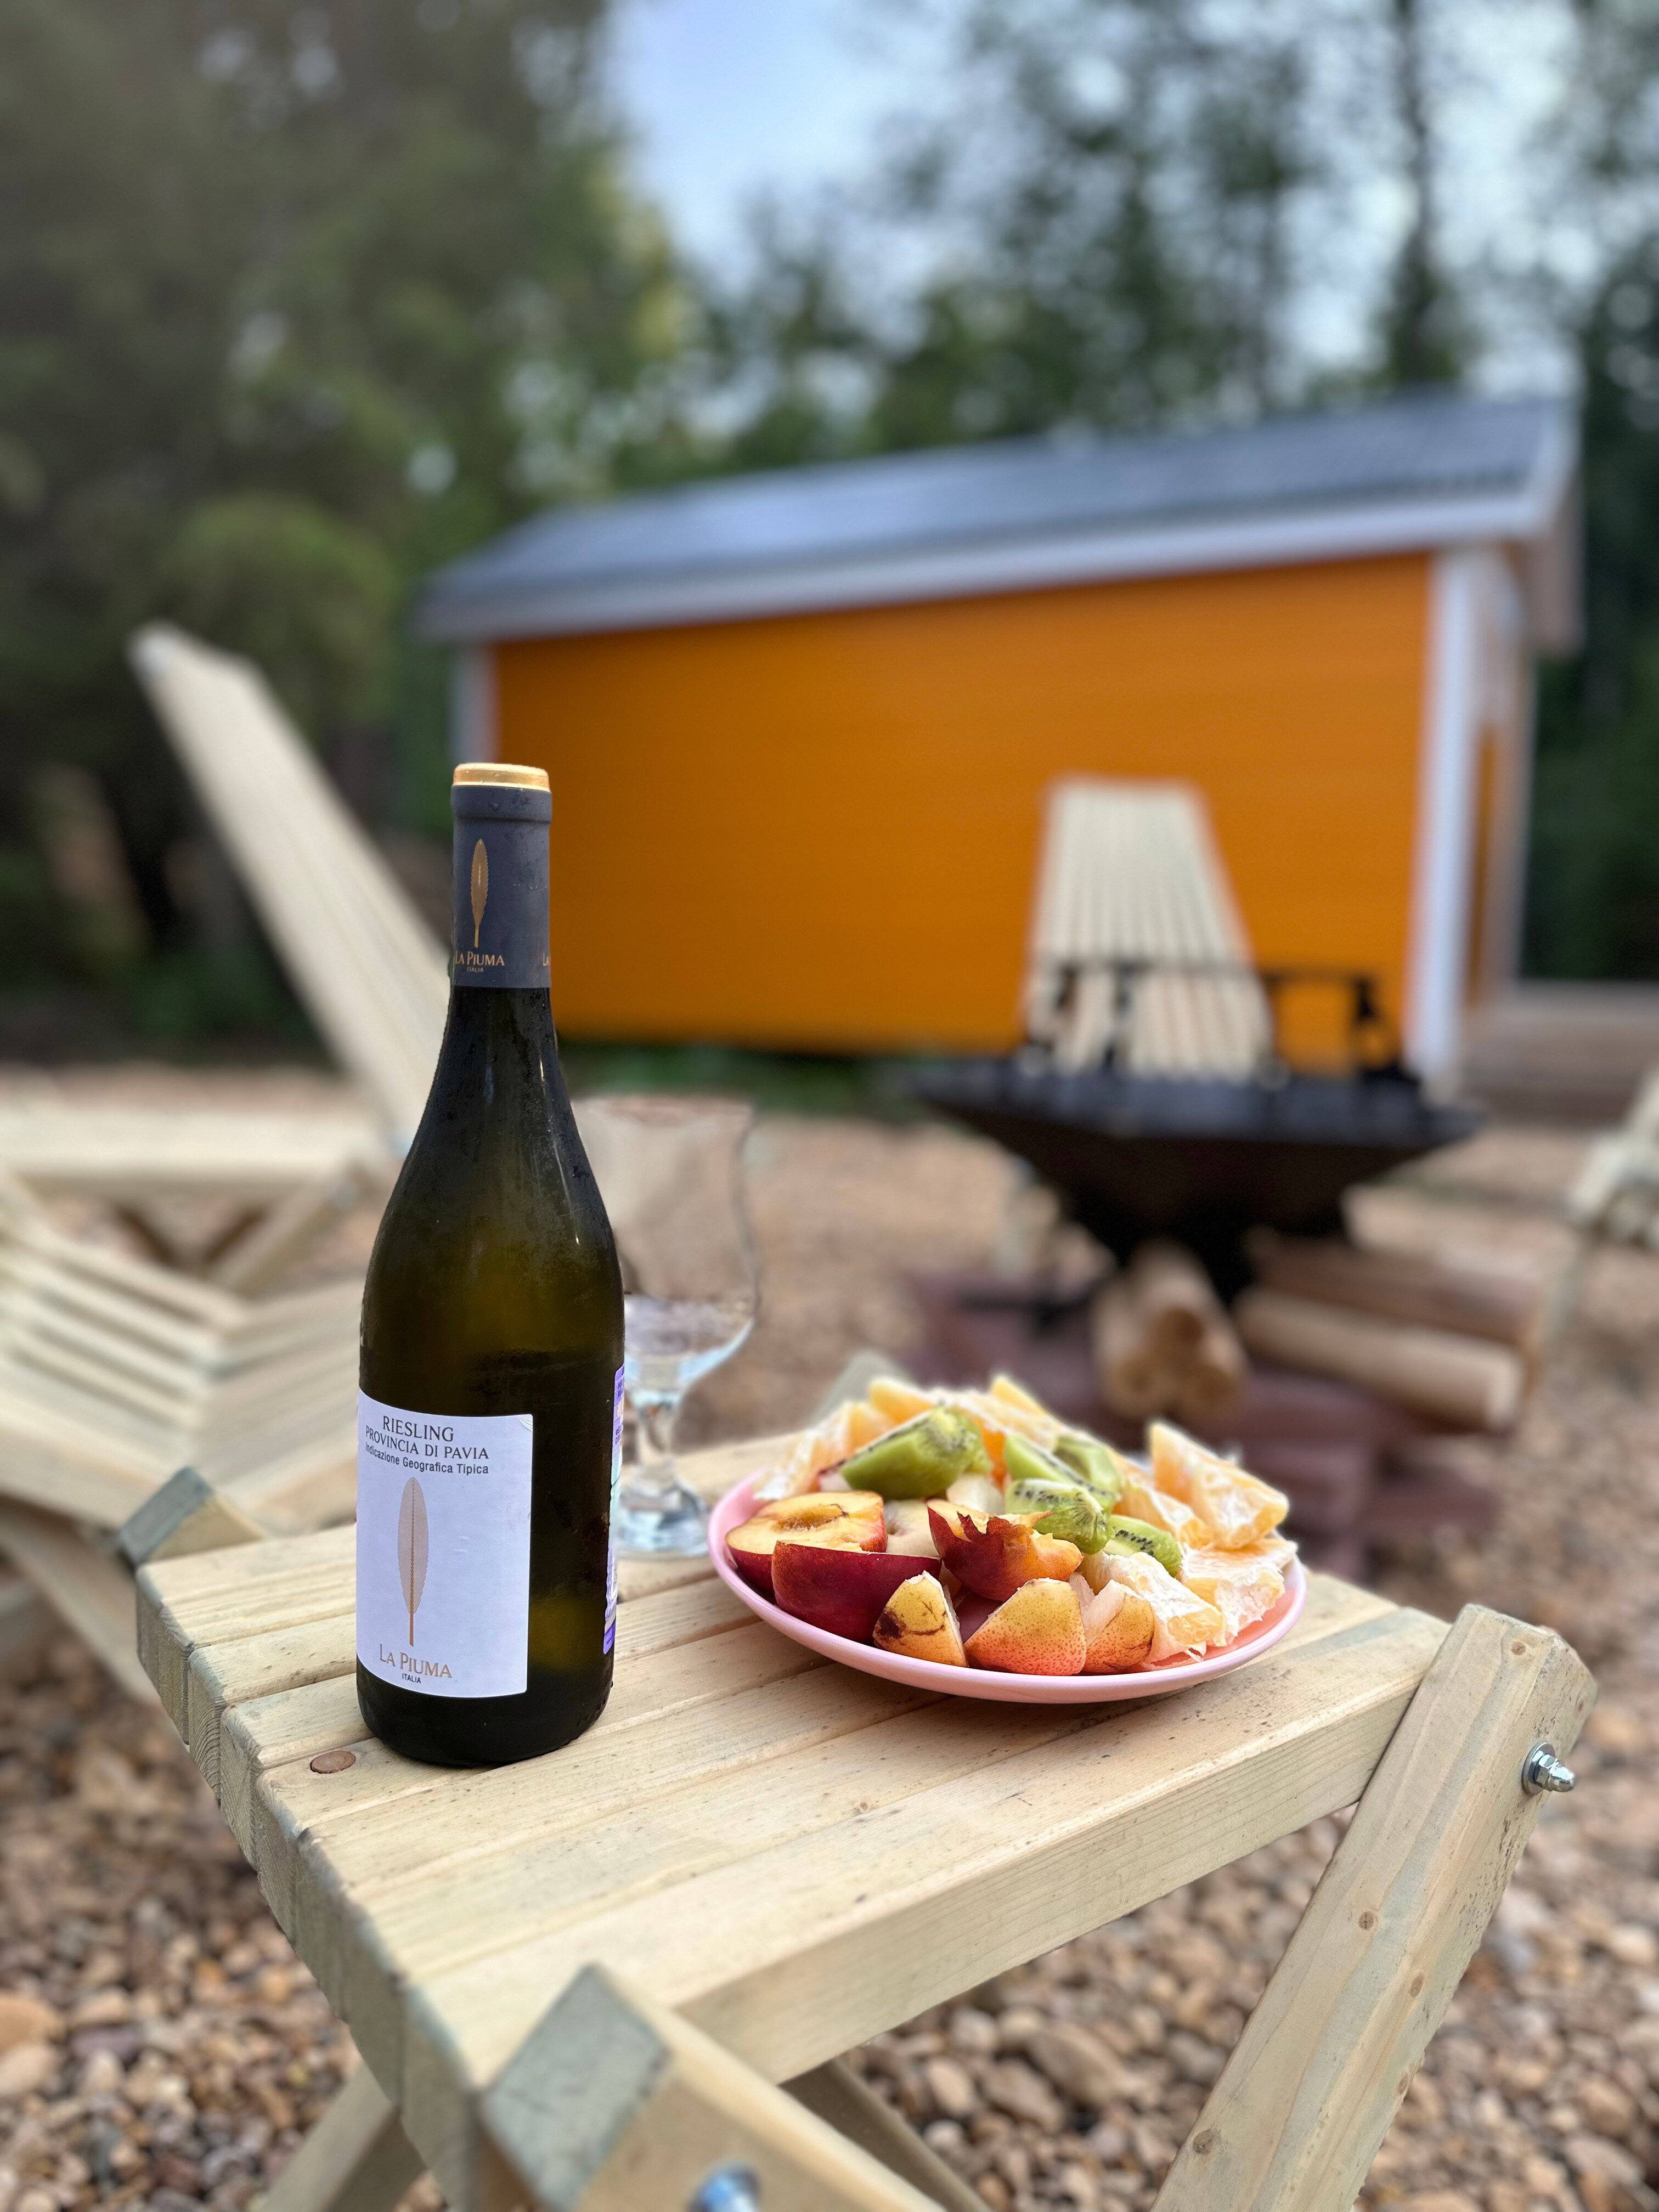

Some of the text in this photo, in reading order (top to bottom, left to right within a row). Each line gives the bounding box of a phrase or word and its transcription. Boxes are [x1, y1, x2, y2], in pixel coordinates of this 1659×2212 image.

[467, 951, 505, 966] PIUMA
[365, 1425, 489, 1459] PROVINCIA DI PAVIA
[383, 1415, 454, 1442] RIESLING
[365, 1442, 489, 1476] Indicazione Geografica Tipica
[379, 1643, 453, 1678] LA PIUMA
[402, 1673, 421, 1684] ITALIA
